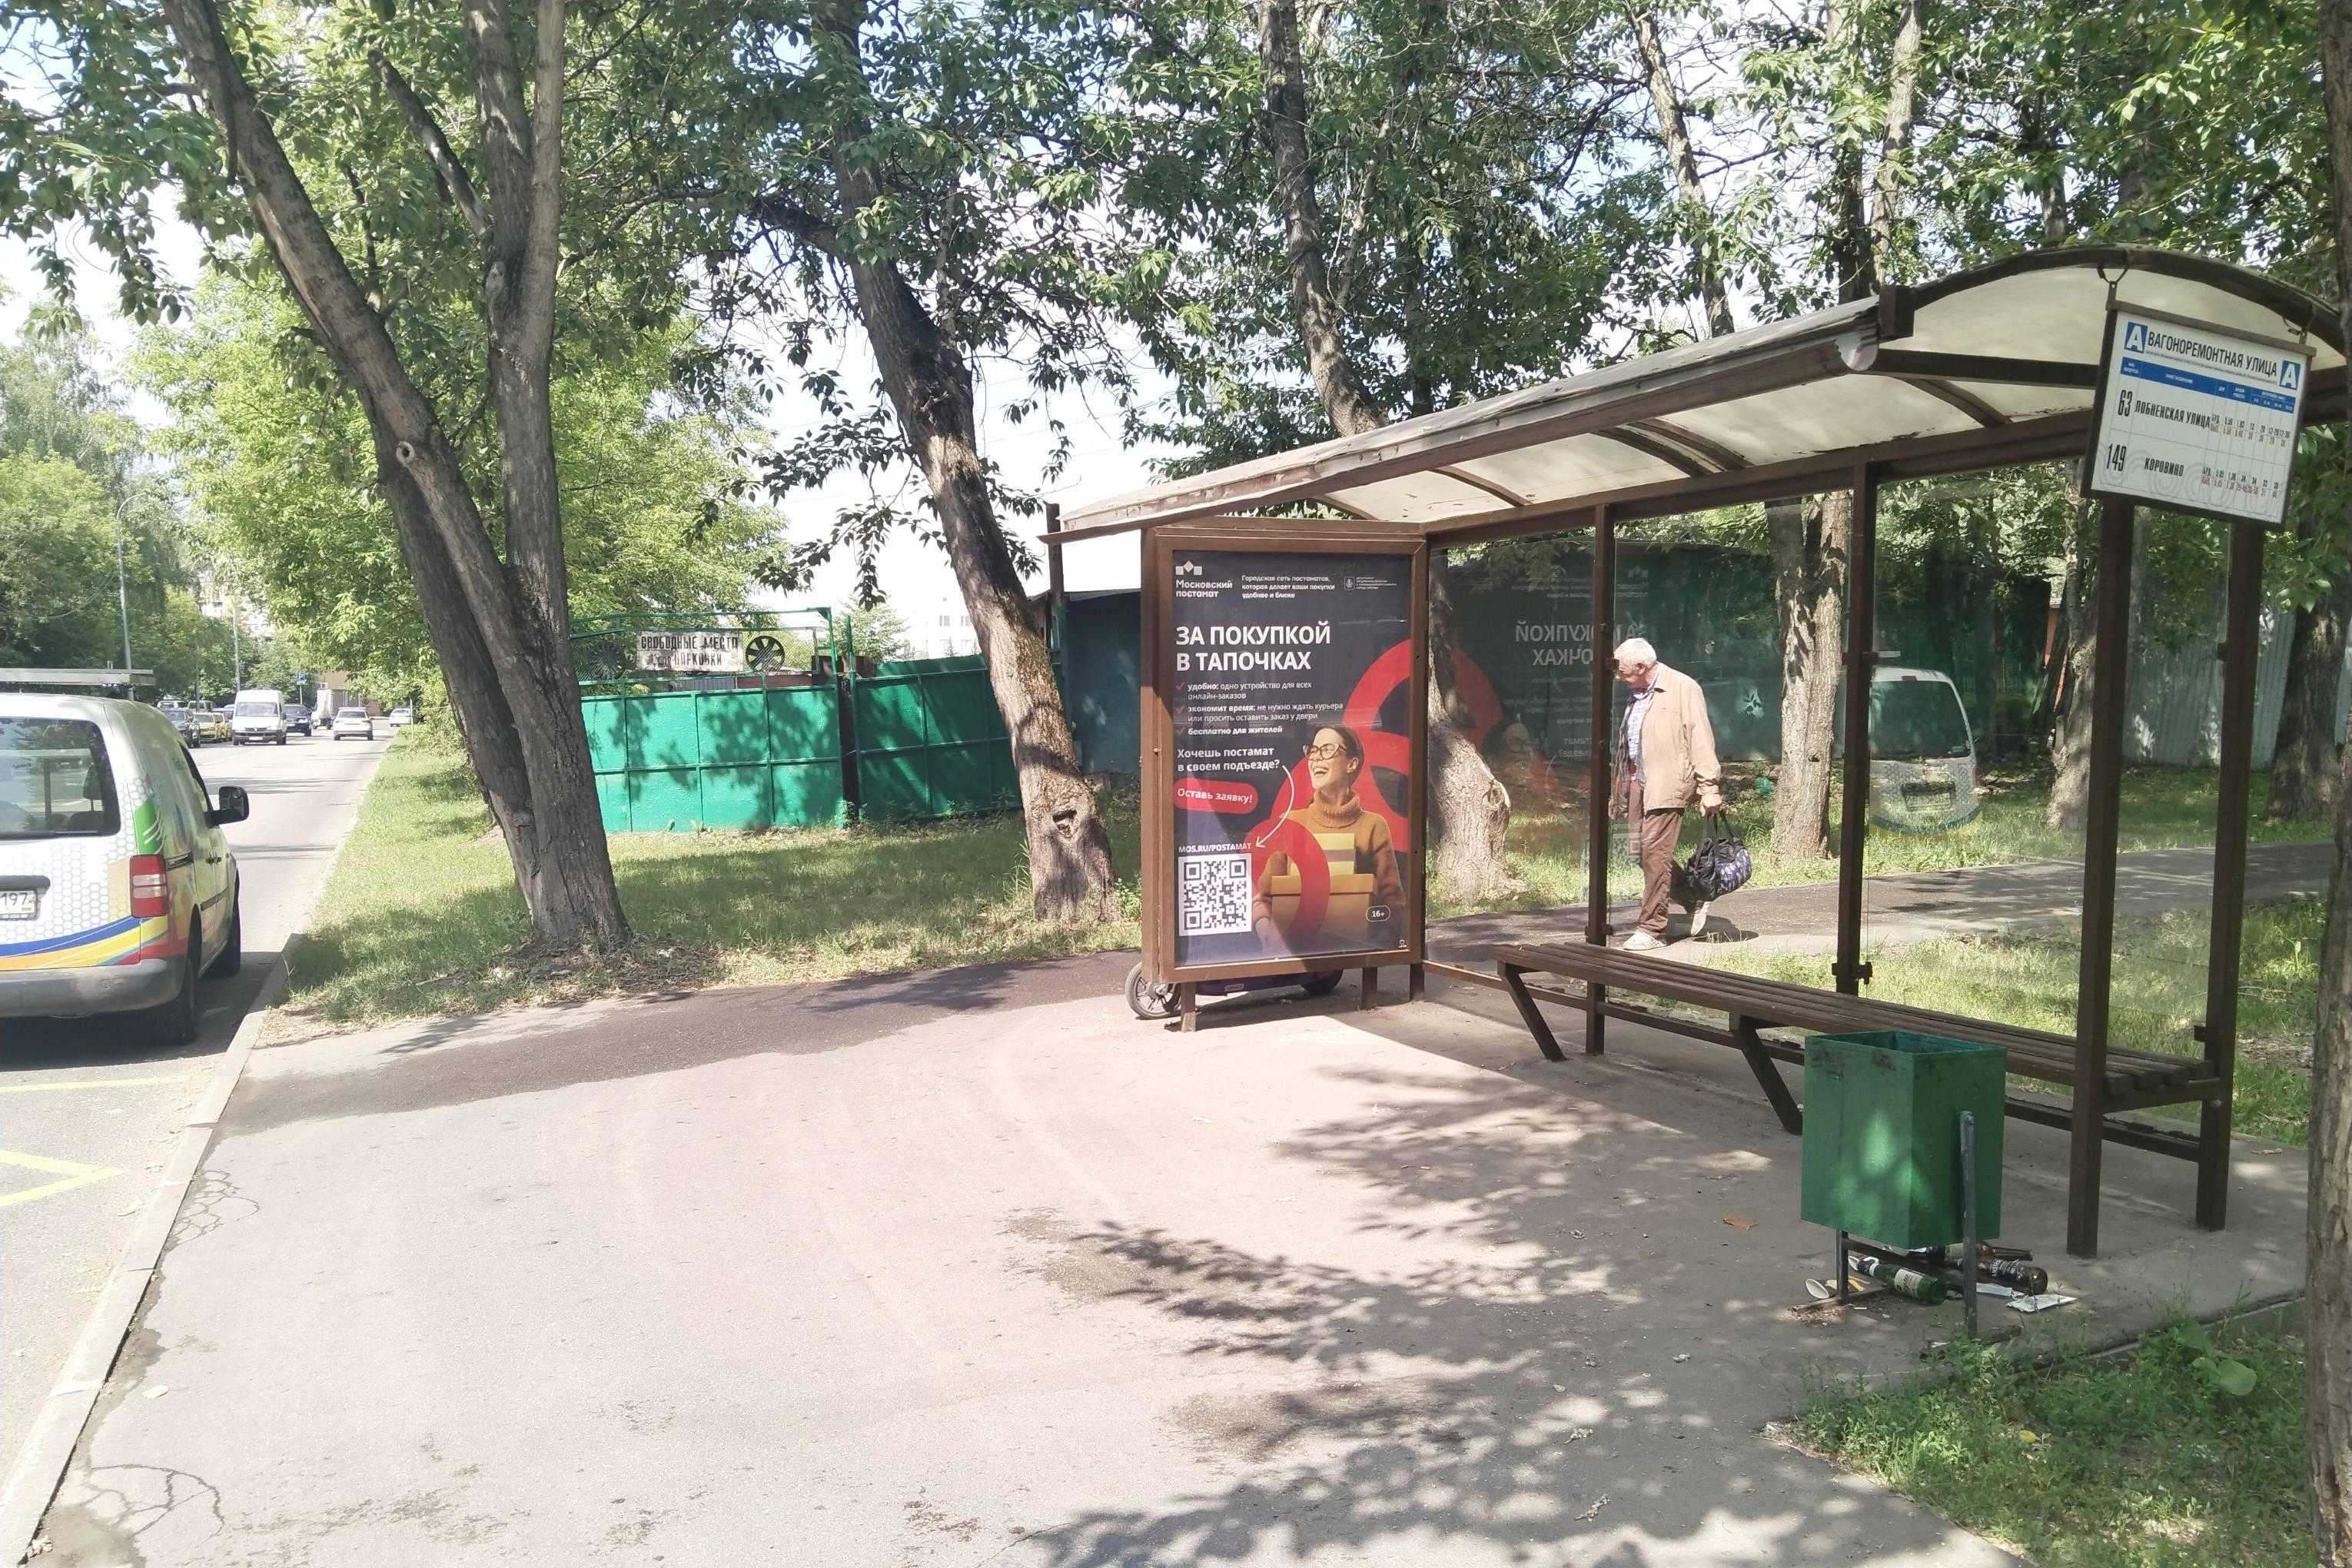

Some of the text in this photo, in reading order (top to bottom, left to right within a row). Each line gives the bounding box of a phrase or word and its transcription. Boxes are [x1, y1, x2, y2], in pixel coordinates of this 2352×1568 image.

[2148, 331, 2244, 368] ВАГОНОРЕМОНТНАЯ
[2245, 355, 2277, 377] УЛИЦА
[2118, 390, 2132, 417] 63
[2134, 400, 2184, 422] ЛОБНЕНСКАЯ
[2185, 411, 2211, 429] УЛИЦА
[2106, 443, 2184, 477] 149 КОРОВИНО
[1176, 579, 1233, 589] Московский
[1176, 620, 1330, 645] ЗА ПОКУПКОЙ
[641, 636, 738, 650] СВОБОДНЫЕ МЕСТА
[1177, 651, 1311, 671] В ТАПОЧКАХ
[1188, 683, 1219, 692] удобно:
[1240, 682, 1281, 691] устройство
[1228, 705, 1256, 713] время:
[1315, 703, 1344, 711] курьера
[1204, 715, 1234, 723] просить
[1178, 748, 1274, 759] Хочешь постамат
[1187, 762, 1220, 772] своем
[1224, 759, 1280, 772] подъезде?
[1178, 788, 1253, 804] Оставь заявку!
[1178, 842, 1251, 852] MOS.RU/POSTAMAT
[0, 892, 28, 905] 197
